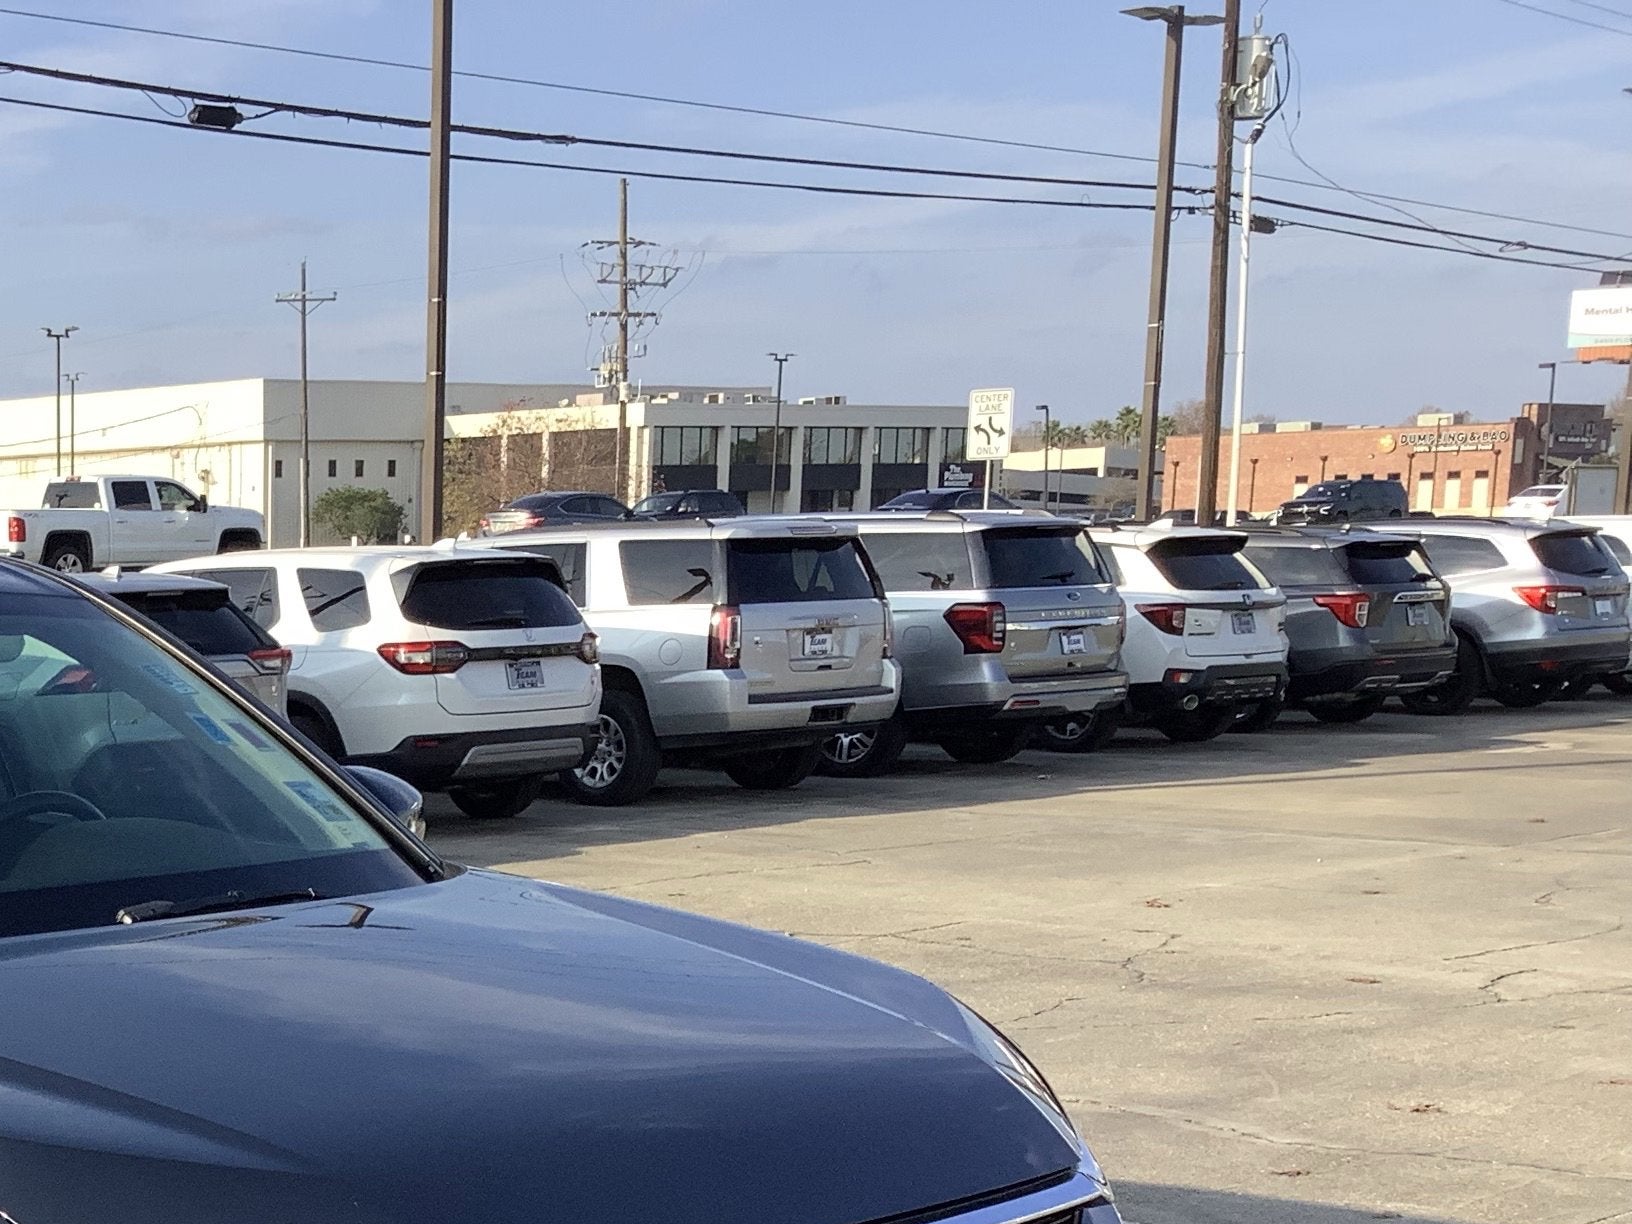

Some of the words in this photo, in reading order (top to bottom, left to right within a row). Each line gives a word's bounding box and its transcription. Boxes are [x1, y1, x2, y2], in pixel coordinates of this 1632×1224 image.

[974, 393, 1009, 404] CENTER
[978, 403, 1004, 413] LANE
[976, 446, 1001, 456] ONLY
